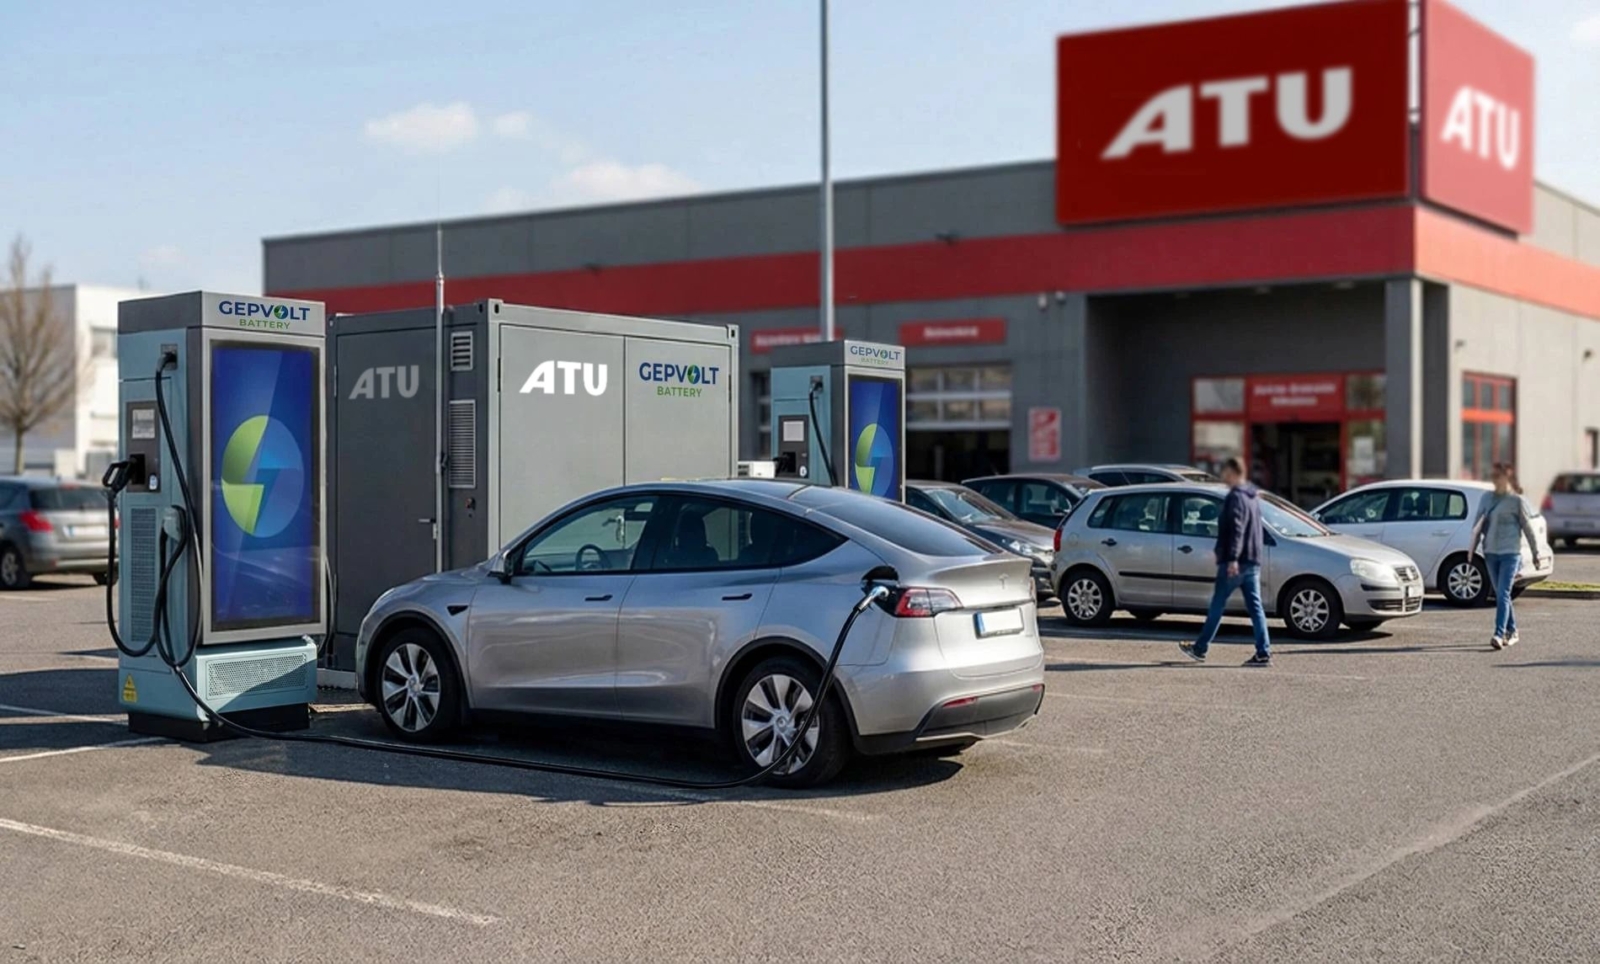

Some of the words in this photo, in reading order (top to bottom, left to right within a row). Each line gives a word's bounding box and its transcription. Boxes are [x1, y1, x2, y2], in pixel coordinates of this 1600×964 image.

[1101, 66, 1353, 160] ATU
[1440, 86, 1521, 170] ATU
[219, 301, 310, 320] GEPVOLT
[239, 319, 290, 329] BATTERY
[850, 346, 901, 360] GEPVOLT
[349, 365, 419, 399] ATU
[519, 360, 608, 396] ATU
[639, 362, 719, 384] GEPVOLT
[657, 386, 702, 397] BATTERY
